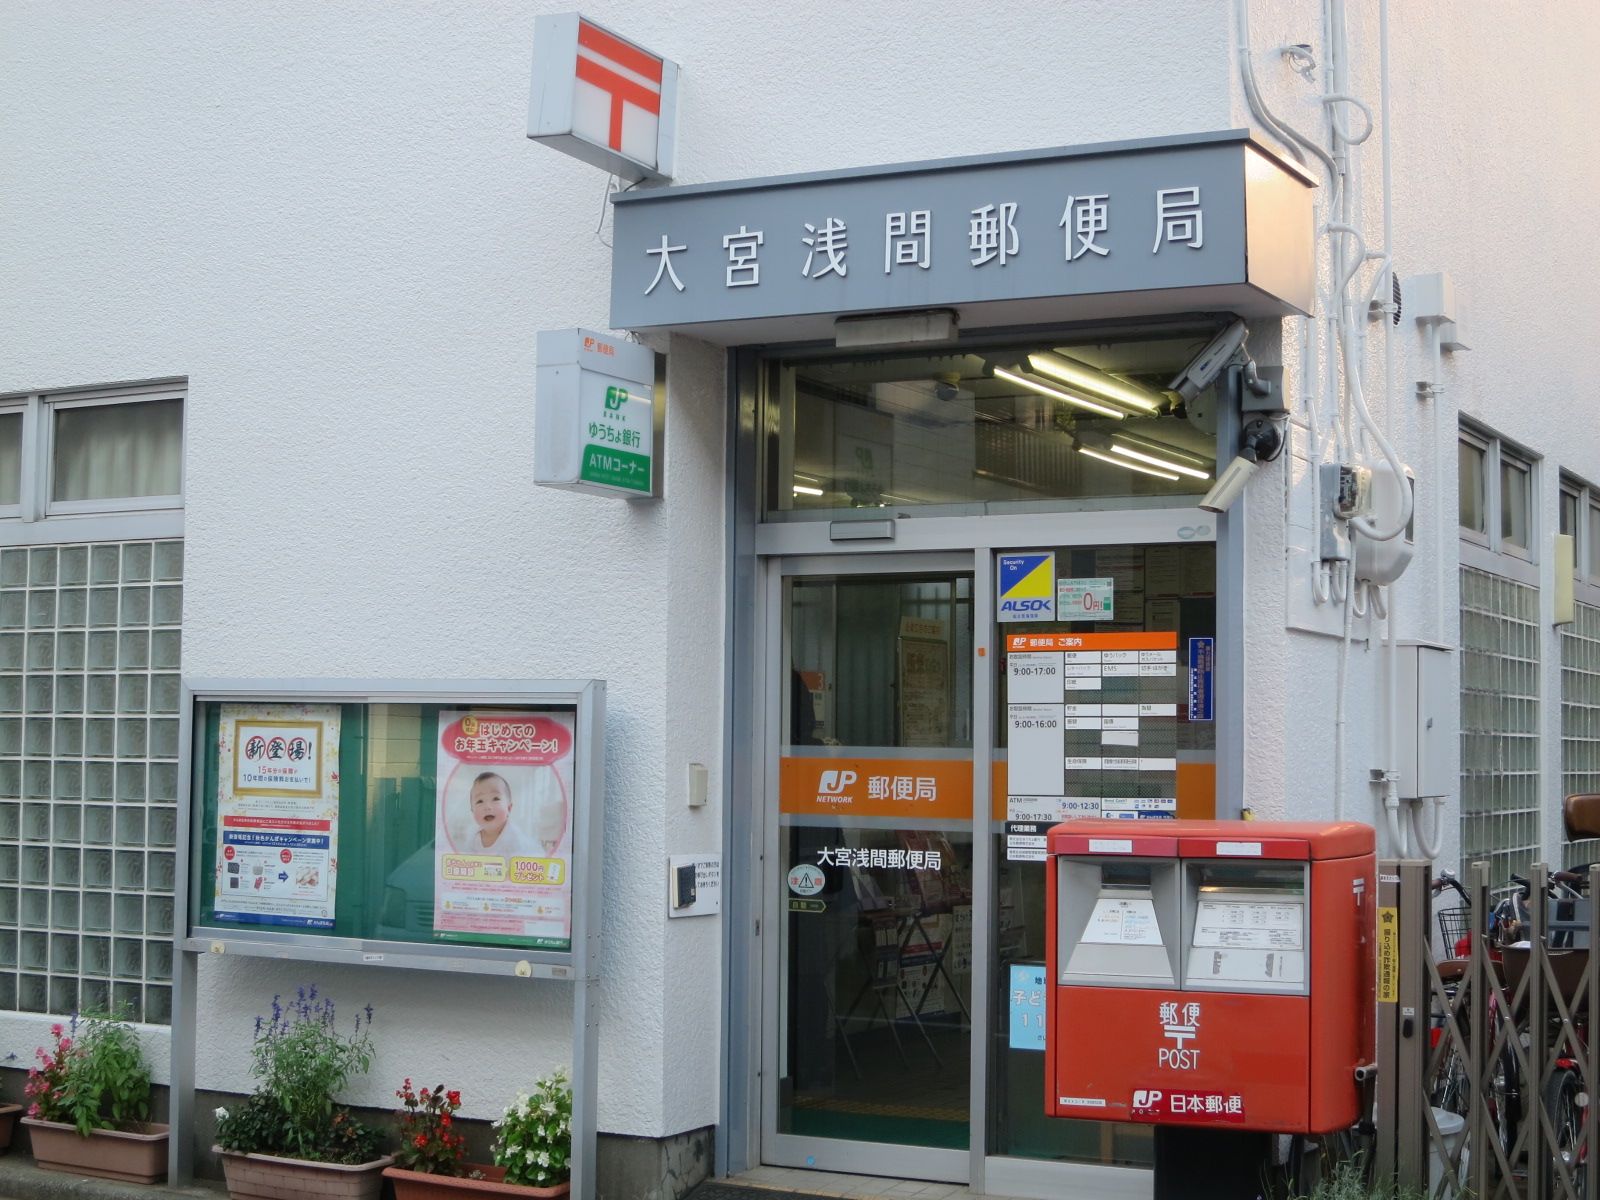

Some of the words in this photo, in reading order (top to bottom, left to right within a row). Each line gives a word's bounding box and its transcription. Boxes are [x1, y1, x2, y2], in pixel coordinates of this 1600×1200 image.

[644, 186, 1204, 295] 大宮浅間郵便局
[604, 386, 629, 411] JP
[603, 411, 626, 422] BANK
[589, 422, 641, 449] ゆうちょ銀行
[589, 453, 645, 475] ATMコーナー
[1001, 600, 1051, 611] ALSOK
[1030, 638, 1054, 647] 郵便局
[1058, 638, 1082, 647] ご案内
[1014, 667, 1056, 676] 9:00-17:00
[480, 723, 535, 737] はじめての
[1014, 720, 1057, 728] 9:00-16:00
[246, 737, 312, 761] 新登場!
[455, 738, 558, 753] お年玉キャンペーン!
[818, 770, 857, 793] JP
[868, 776, 937, 801] 郵便局
[1062, 802, 1100, 810] 9:00-12:30
[1010, 825, 1037, 833] 代理業務
[817, 847, 942, 871] 大宮浅間郵便局
[1013, 990, 1046, 1006] 子ど
[1159, 1002, 1200, 1026] 郵便
[1159, 1047, 1200, 1070] POST
[1133, 1090, 1162, 1108] JP
[1170, 1094, 1242, 1114] 日本郵便
